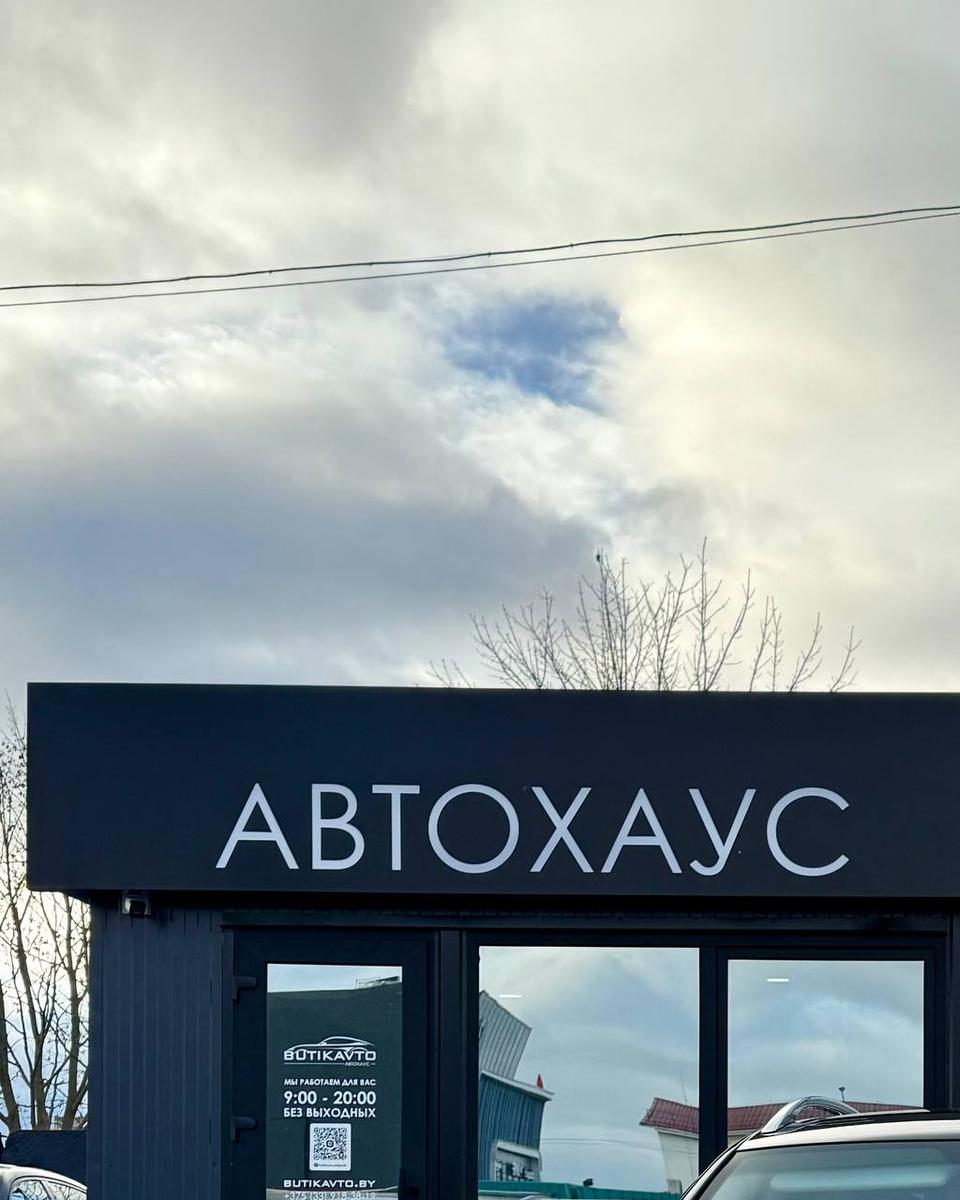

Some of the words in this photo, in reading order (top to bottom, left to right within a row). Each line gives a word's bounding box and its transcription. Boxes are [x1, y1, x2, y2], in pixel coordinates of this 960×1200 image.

[215, 782, 850, 877] АВТОХАУС
[283, 1050, 376, 1061] BUTIKAVTO
[341, 1079, 358, 1087] ДЛЯ
[284, 1090, 318, 1105] 9:00
[333, 1090, 377, 1105] 20:00
[283, 1107, 303, 1118] БЕЗ
[306, 1107, 376, 1119] ВЫХОДНЫХ
[283, 1179, 376, 1188] BUTIKAVTO.BY
